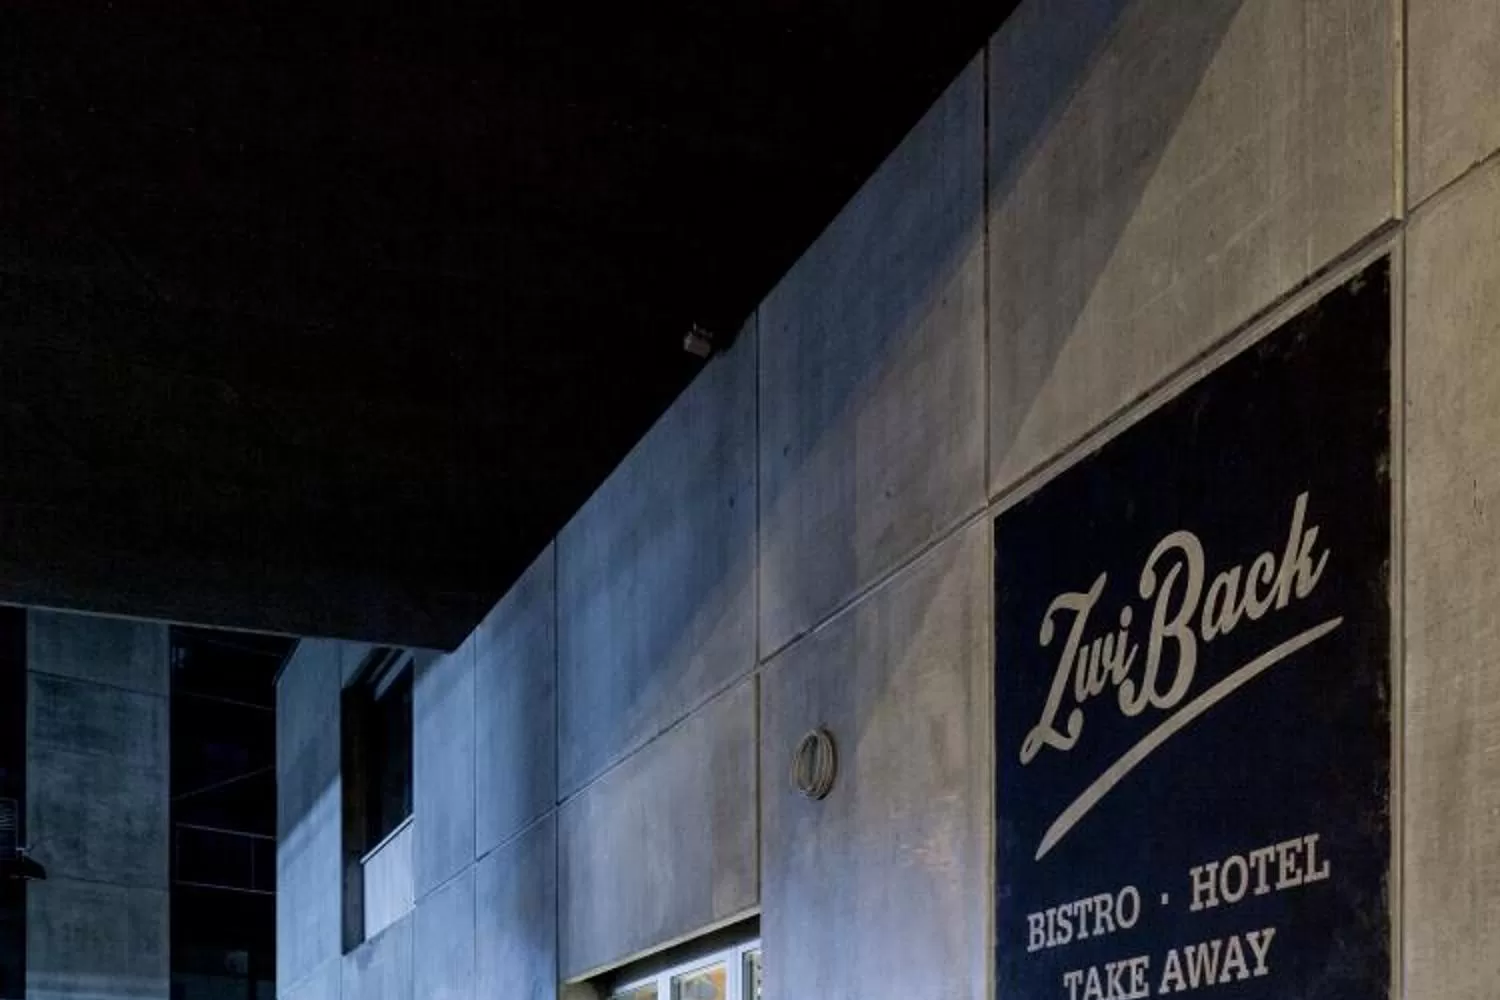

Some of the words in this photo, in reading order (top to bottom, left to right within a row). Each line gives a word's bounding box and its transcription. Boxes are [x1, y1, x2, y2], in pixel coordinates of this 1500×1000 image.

[1019, 491, 1330, 765] ZwiBack
[1027, 886, 1141, 952] BISTRO
[1189, 833, 1330, 912] HOTEL
[1158, 928, 1276, 994] AWAY
